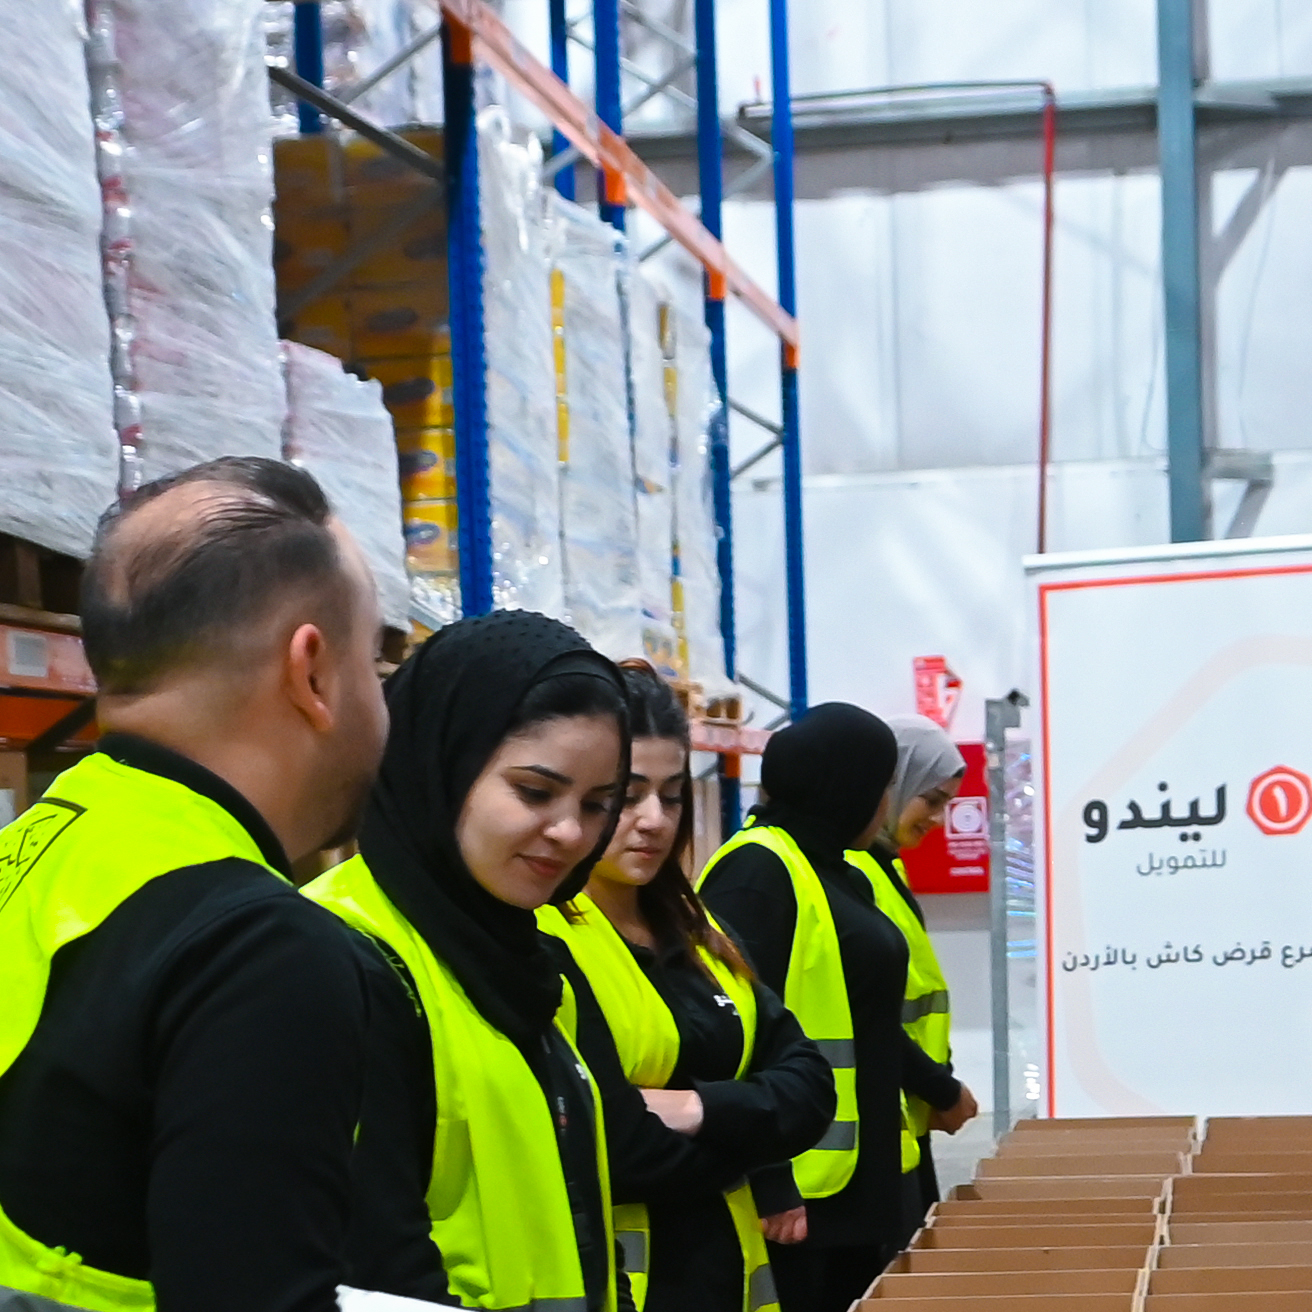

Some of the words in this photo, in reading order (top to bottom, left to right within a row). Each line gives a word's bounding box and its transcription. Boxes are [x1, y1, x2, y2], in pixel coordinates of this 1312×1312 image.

[1082, 781, 1228, 843] ليندو
[1136, 848, 1227, 877] للتمويل
[1061, 943, 1138, 972] بالأردن
[1146, 940, 1204, 969] كاش
[1212, 941, 1273, 967] قرض
